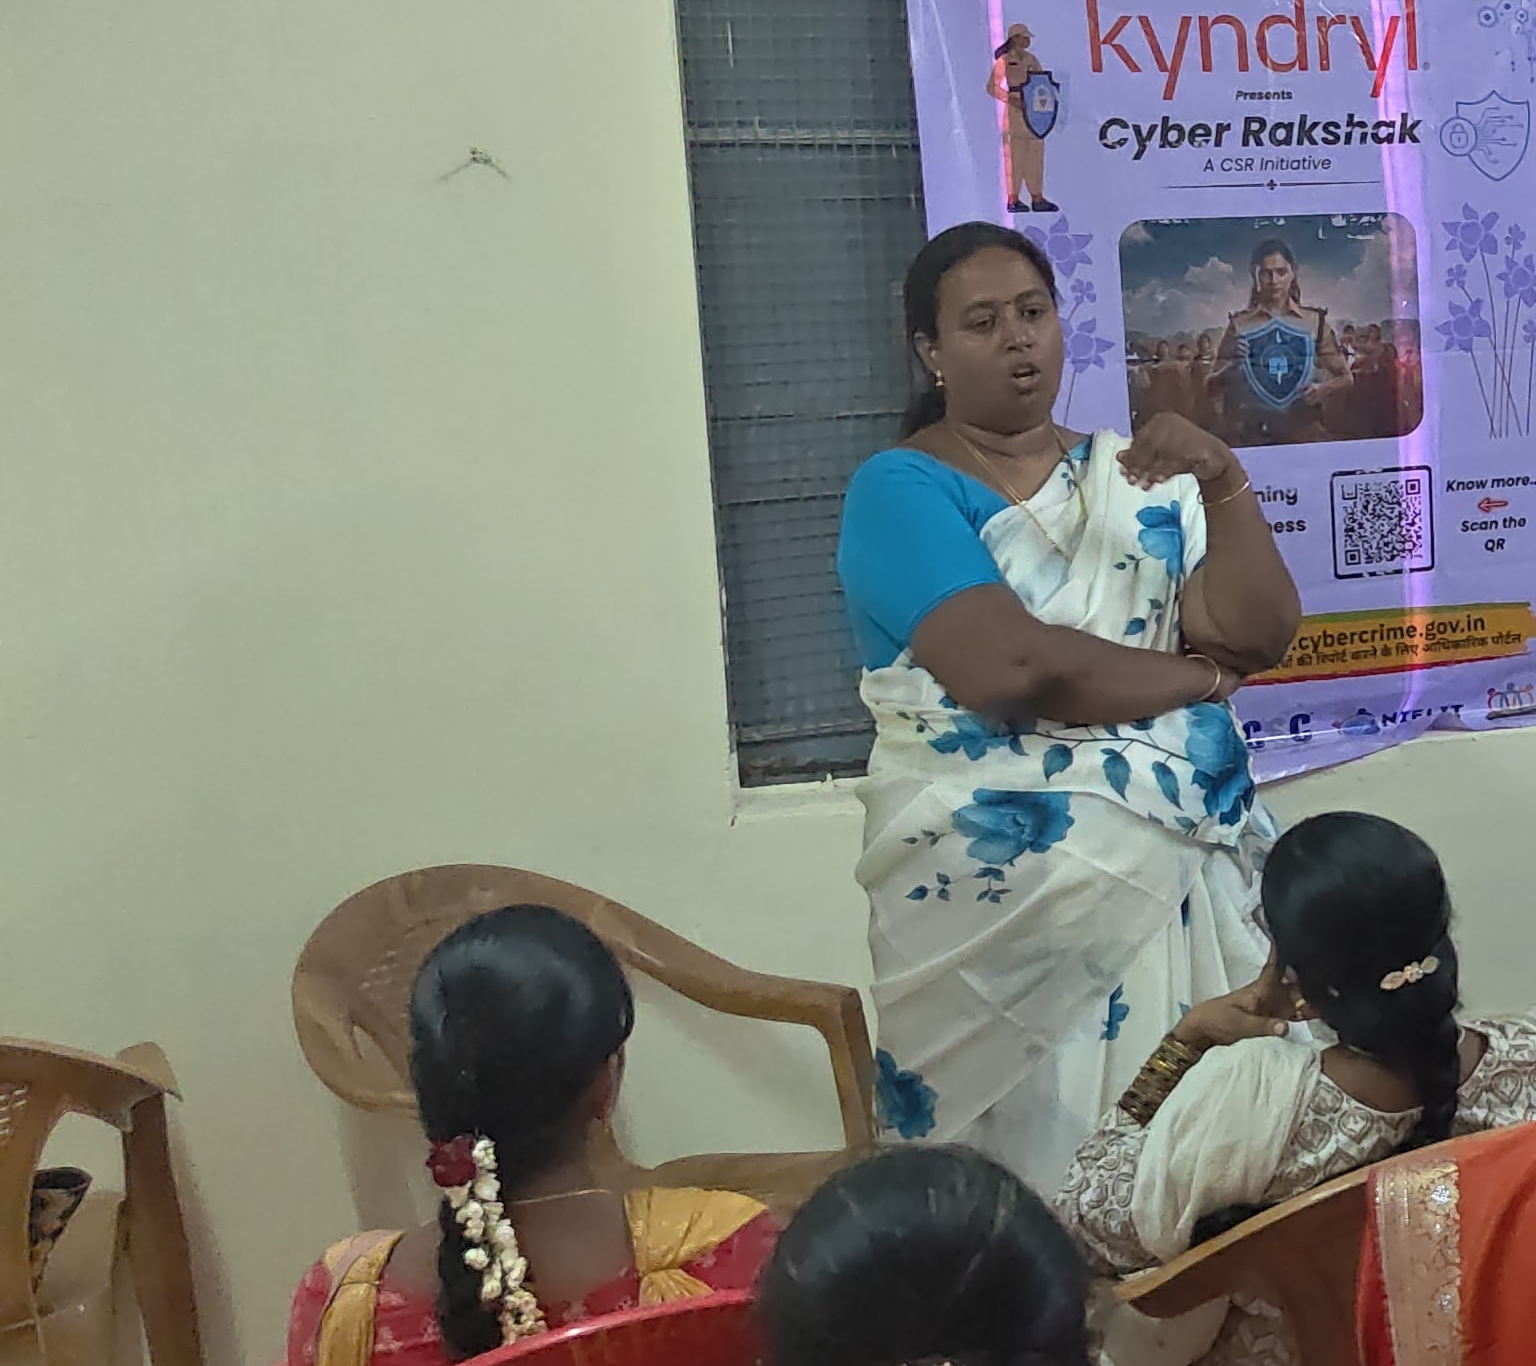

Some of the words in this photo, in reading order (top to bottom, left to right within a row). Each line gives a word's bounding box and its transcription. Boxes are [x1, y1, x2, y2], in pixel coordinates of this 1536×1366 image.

[1236, 89, 1293, 101] Presents
[1098, 115, 1232, 161] Cyber
[1241, 112, 1423, 148] Rakshak
[1203, 159, 1215, 173] A
[1220, 157, 1254, 172] CSR
[1259, 153, 1332, 171] Initiative
[1446, 479, 1489, 493] Know
[1461, 520, 1499, 533] Scan
[1502, 516, 1527, 529] the
[1484, 538, 1506, 553] QR
[1291, 614, 1486, 654] .cybercrime.gov.in
